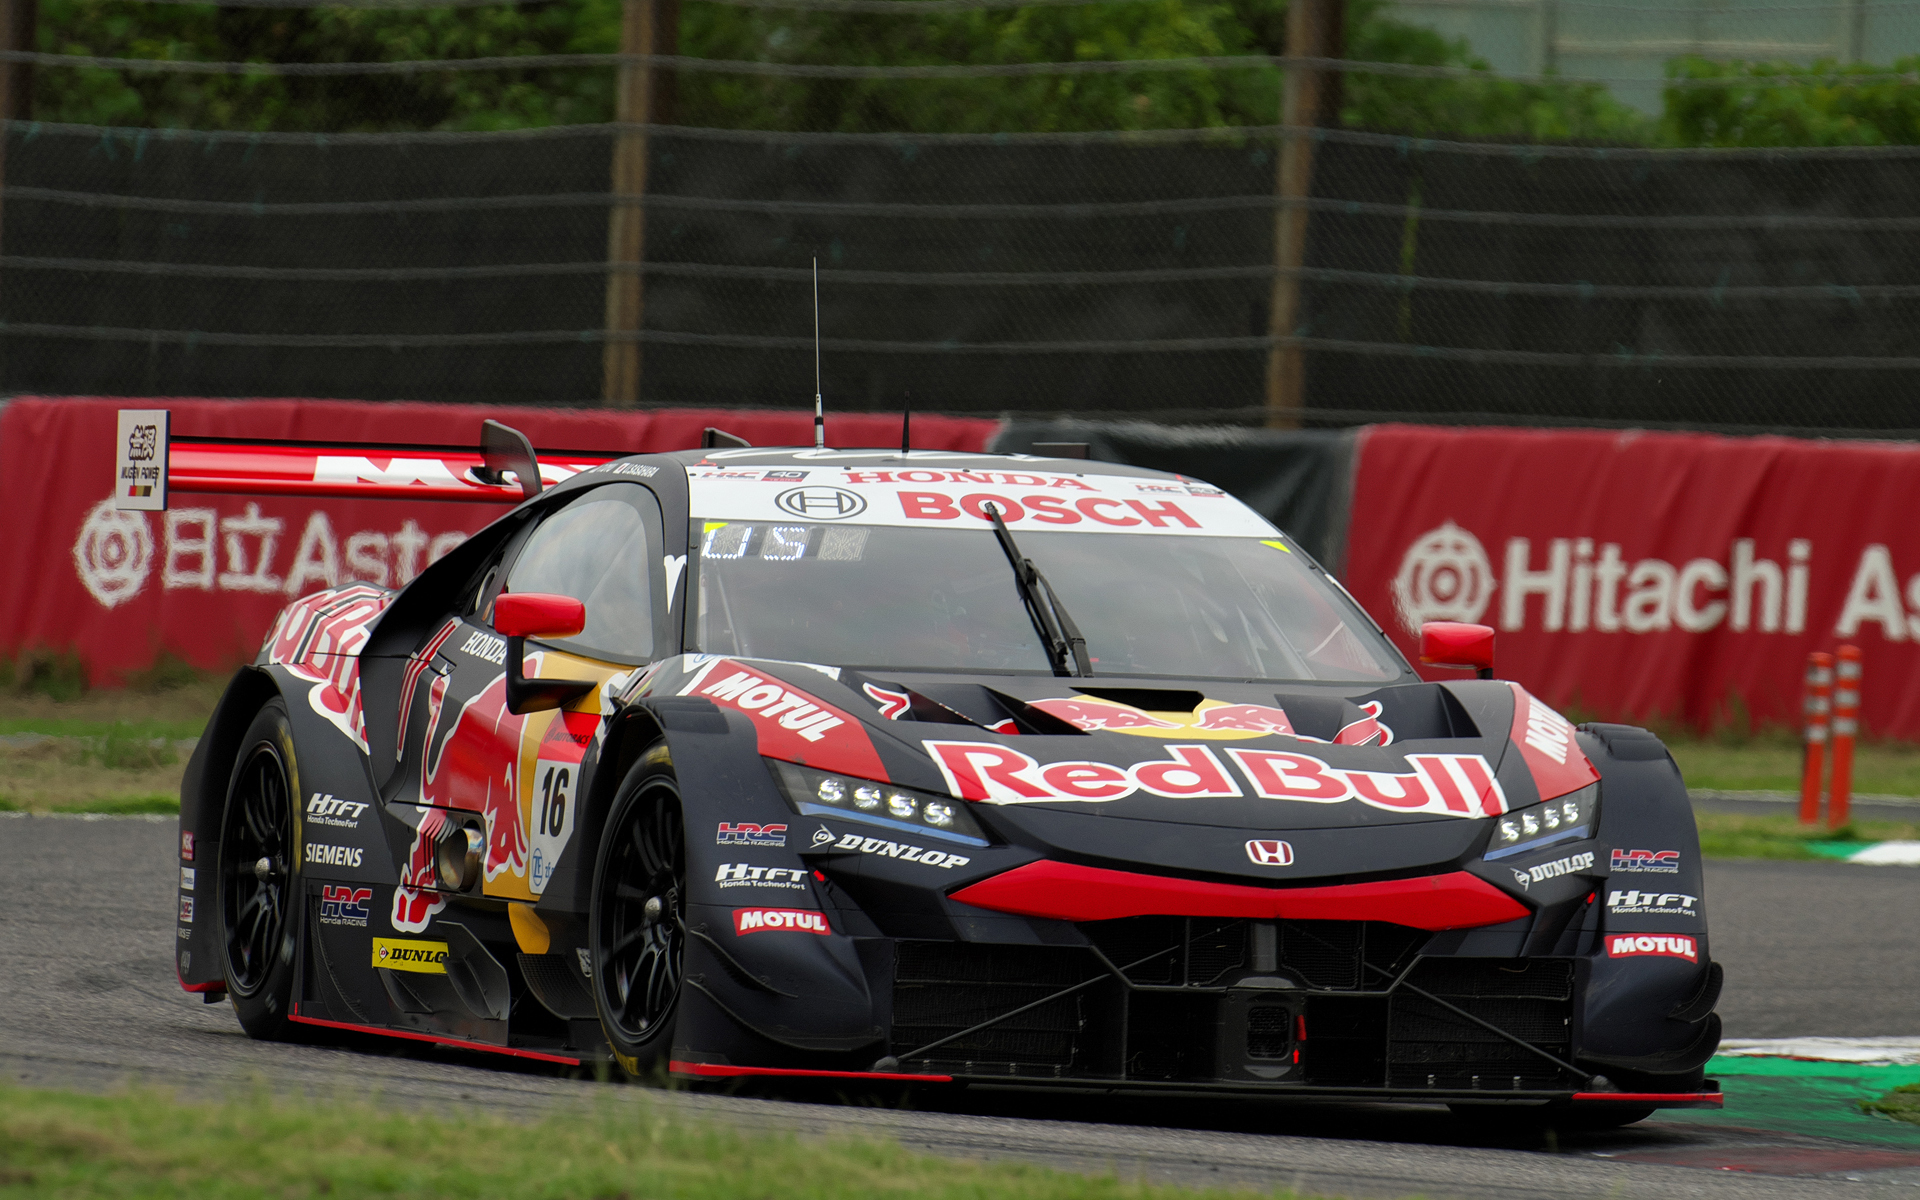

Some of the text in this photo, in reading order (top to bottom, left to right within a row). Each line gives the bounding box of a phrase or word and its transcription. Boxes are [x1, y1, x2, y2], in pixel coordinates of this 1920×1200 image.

[840, 471, 1101, 491] HONDA
[897, 491, 1202, 528] BOSCH
[1502, 536, 1920, 643] Hitachi A
[460, 630, 508, 665] HONDA
[701, 671, 845, 742] MOTUL
[921, 740, 1509, 818] Red Bull
[307, 792, 370, 818] HTFT
[540, 767, 569, 837] 16
[307, 815, 324, 824] Honda
[717, 822, 788, 842] HRC
[305, 843, 363, 867] SIEMENS
[833, 833, 971, 869] DUNLOP
[1609, 849, 1680, 869] HRC
[715, 863, 808, 882] HTFT
[1528, 851, 1595, 883] DUNLOP
[719, 880, 750, 888] Honda
[320, 885, 372, 918] HRC
[1607, 890, 1697, 907] HTFT
[740, 911, 826, 931] MOTUL
[1612, 906, 1642, 914] Honda
[320, 917, 367, 927] Honda RACING
[1612, 937, 1695, 958] MOTUL
